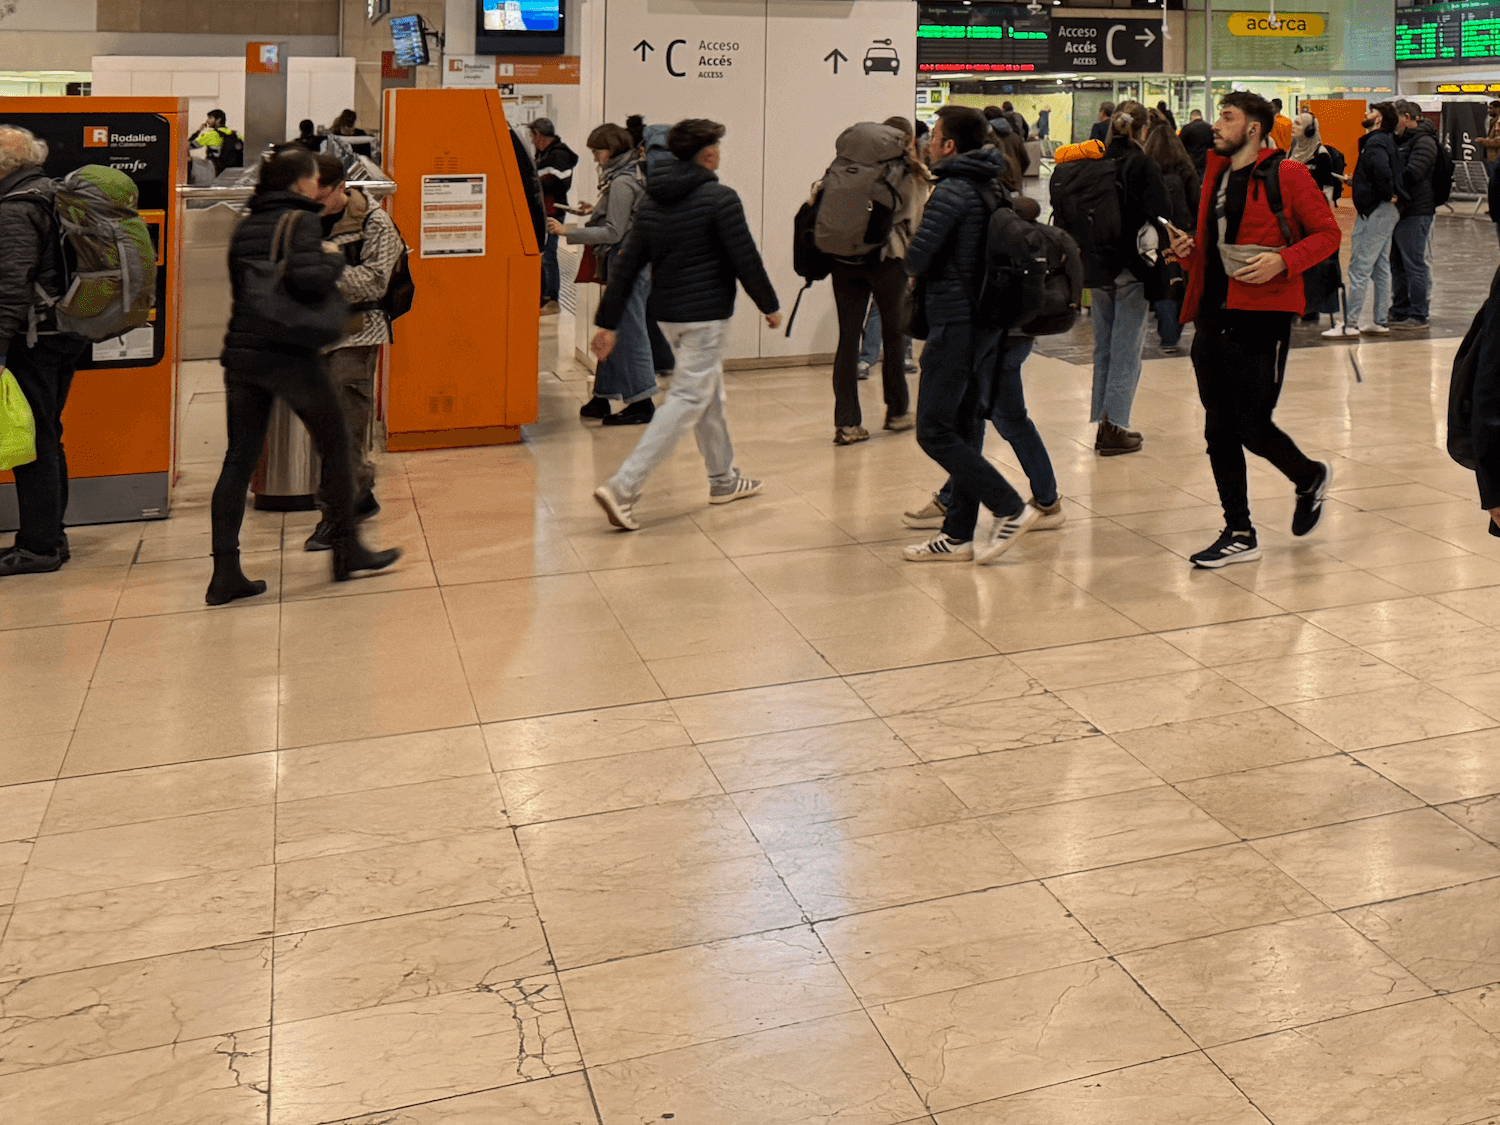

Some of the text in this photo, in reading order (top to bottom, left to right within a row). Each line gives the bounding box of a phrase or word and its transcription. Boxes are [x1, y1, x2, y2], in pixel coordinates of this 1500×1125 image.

[1246, 18, 1307, 31] acerca
[1058, 25, 1097, 37] Acceso
[699, 40, 739, 51] Acceso
[1065, 41, 1097, 53] Accés
[1105, 24, 1127, 66] C
[665, 39, 687, 77] C
[699, 55, 732, 66] Accés
[1072, 57, 1097, 66] ACCESS
[93, 129, 107, 143] R
[110, 133, 157, 143] Rodalies
[109, 159, 147, 173] renfe
